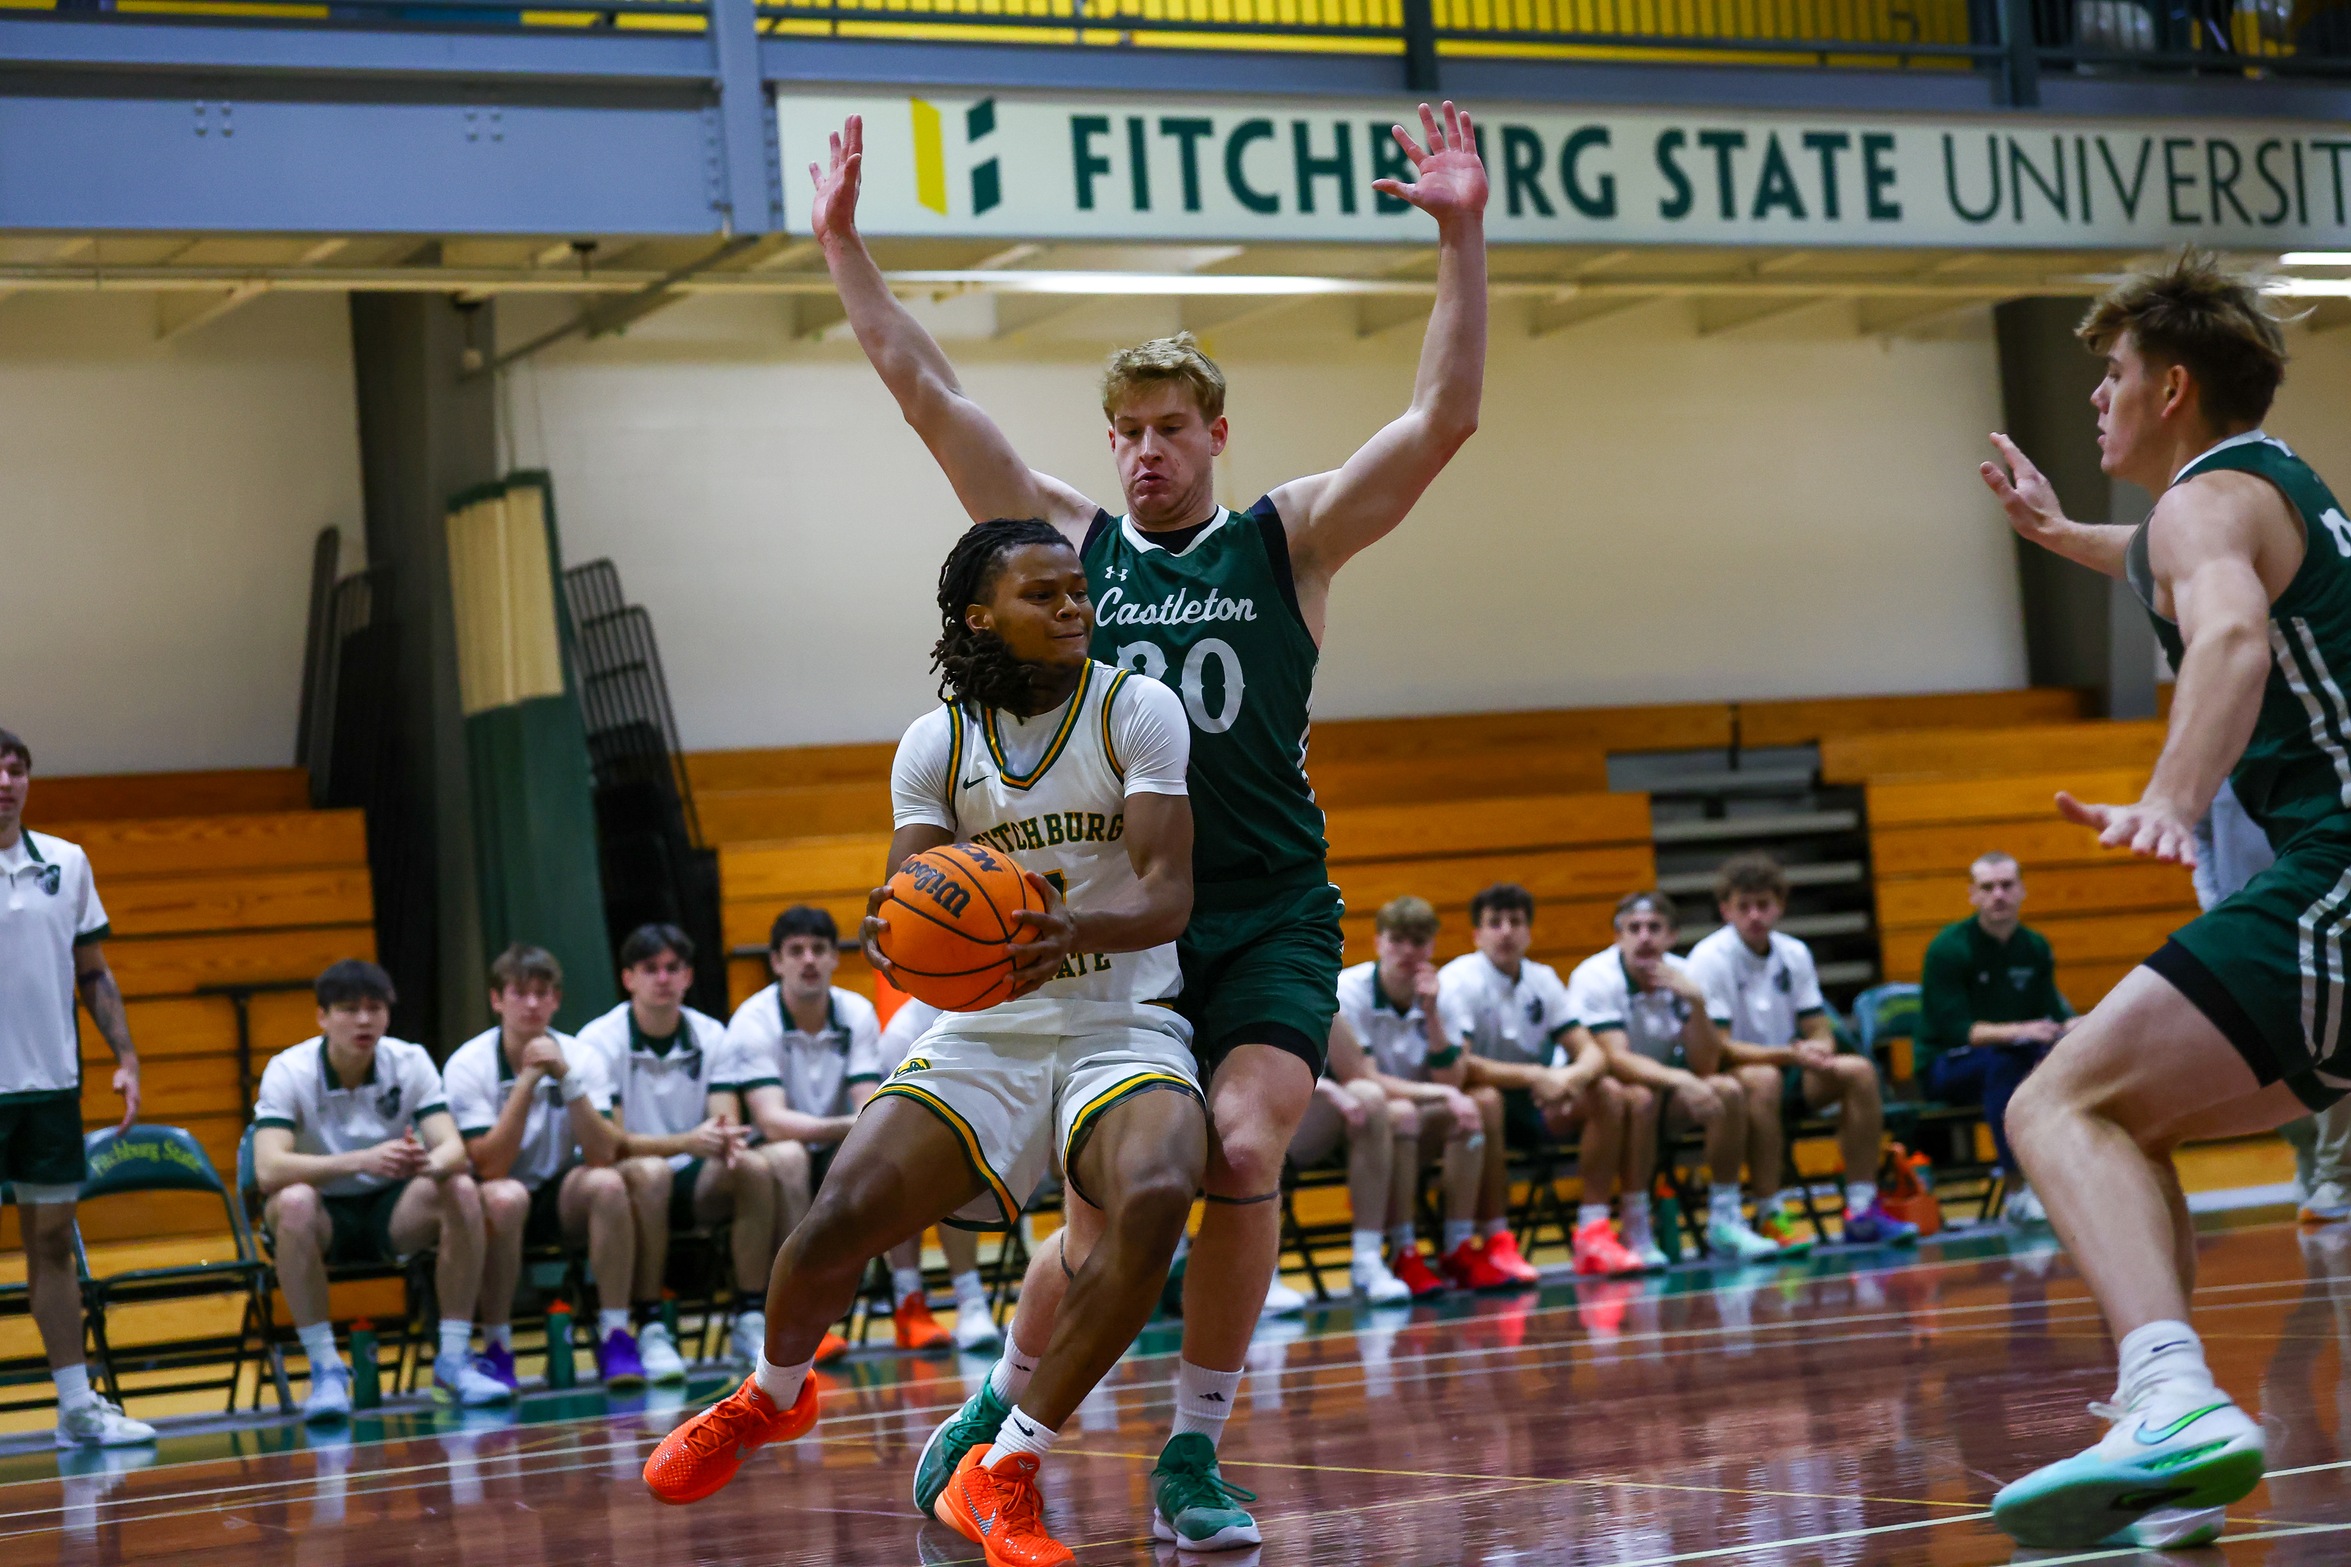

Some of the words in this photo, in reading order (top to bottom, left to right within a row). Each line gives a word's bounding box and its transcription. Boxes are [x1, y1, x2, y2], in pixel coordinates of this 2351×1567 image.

[1069, 114, 1617, 220] FITCHBRG
[1655, 127, 1902, 221] STATE
[1942, 133, 2351, 226] UNIVERSIT
[1095, 586, 1257, 627] Castleton
[1050, 952, 1112, 980] ATE
